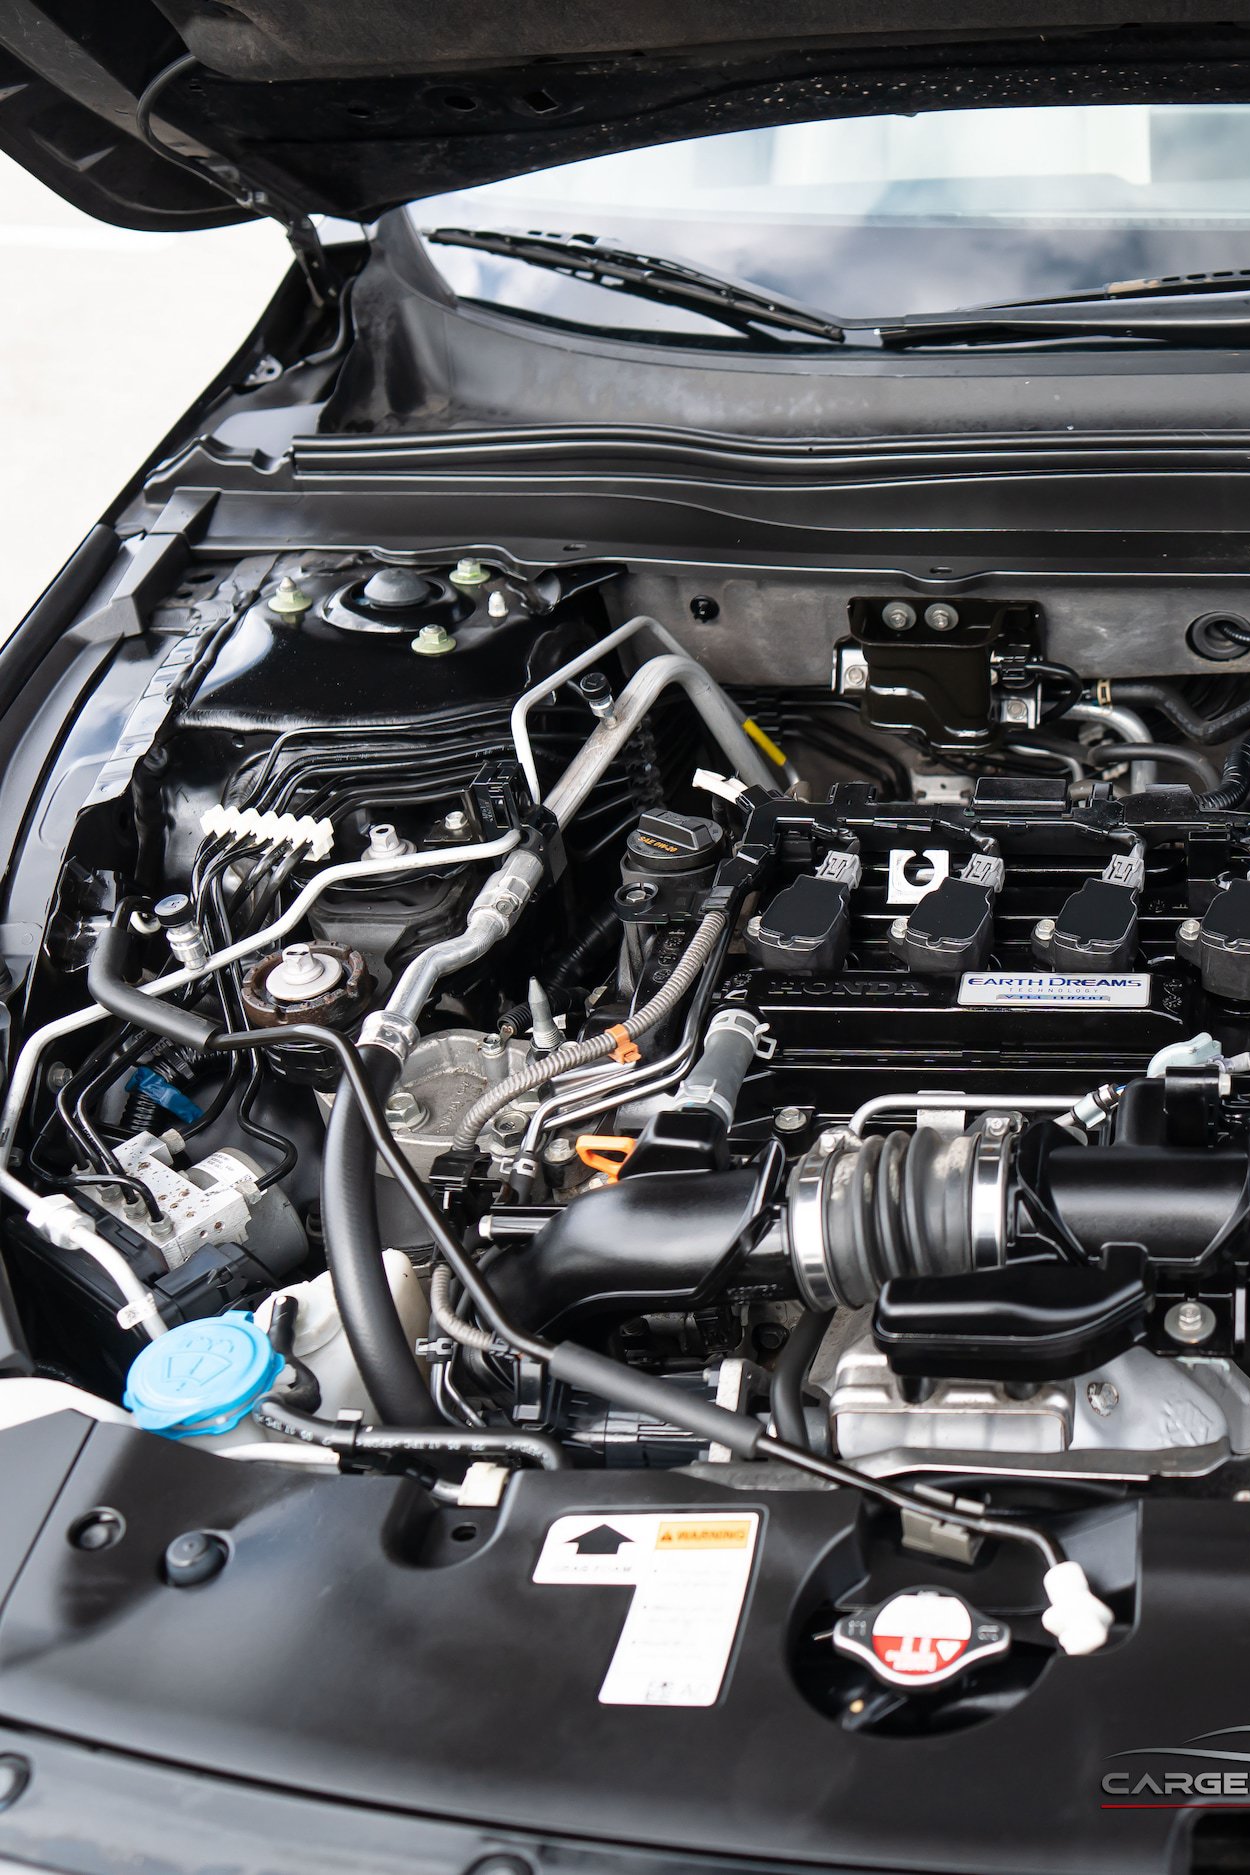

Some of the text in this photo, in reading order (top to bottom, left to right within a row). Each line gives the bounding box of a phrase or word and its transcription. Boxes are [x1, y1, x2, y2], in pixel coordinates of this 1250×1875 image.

[638, 836, 656, 845] SAE
[968, 977, 1142, 987] EARTH DREAMS
[768, 981, 930, 995] HONDA
